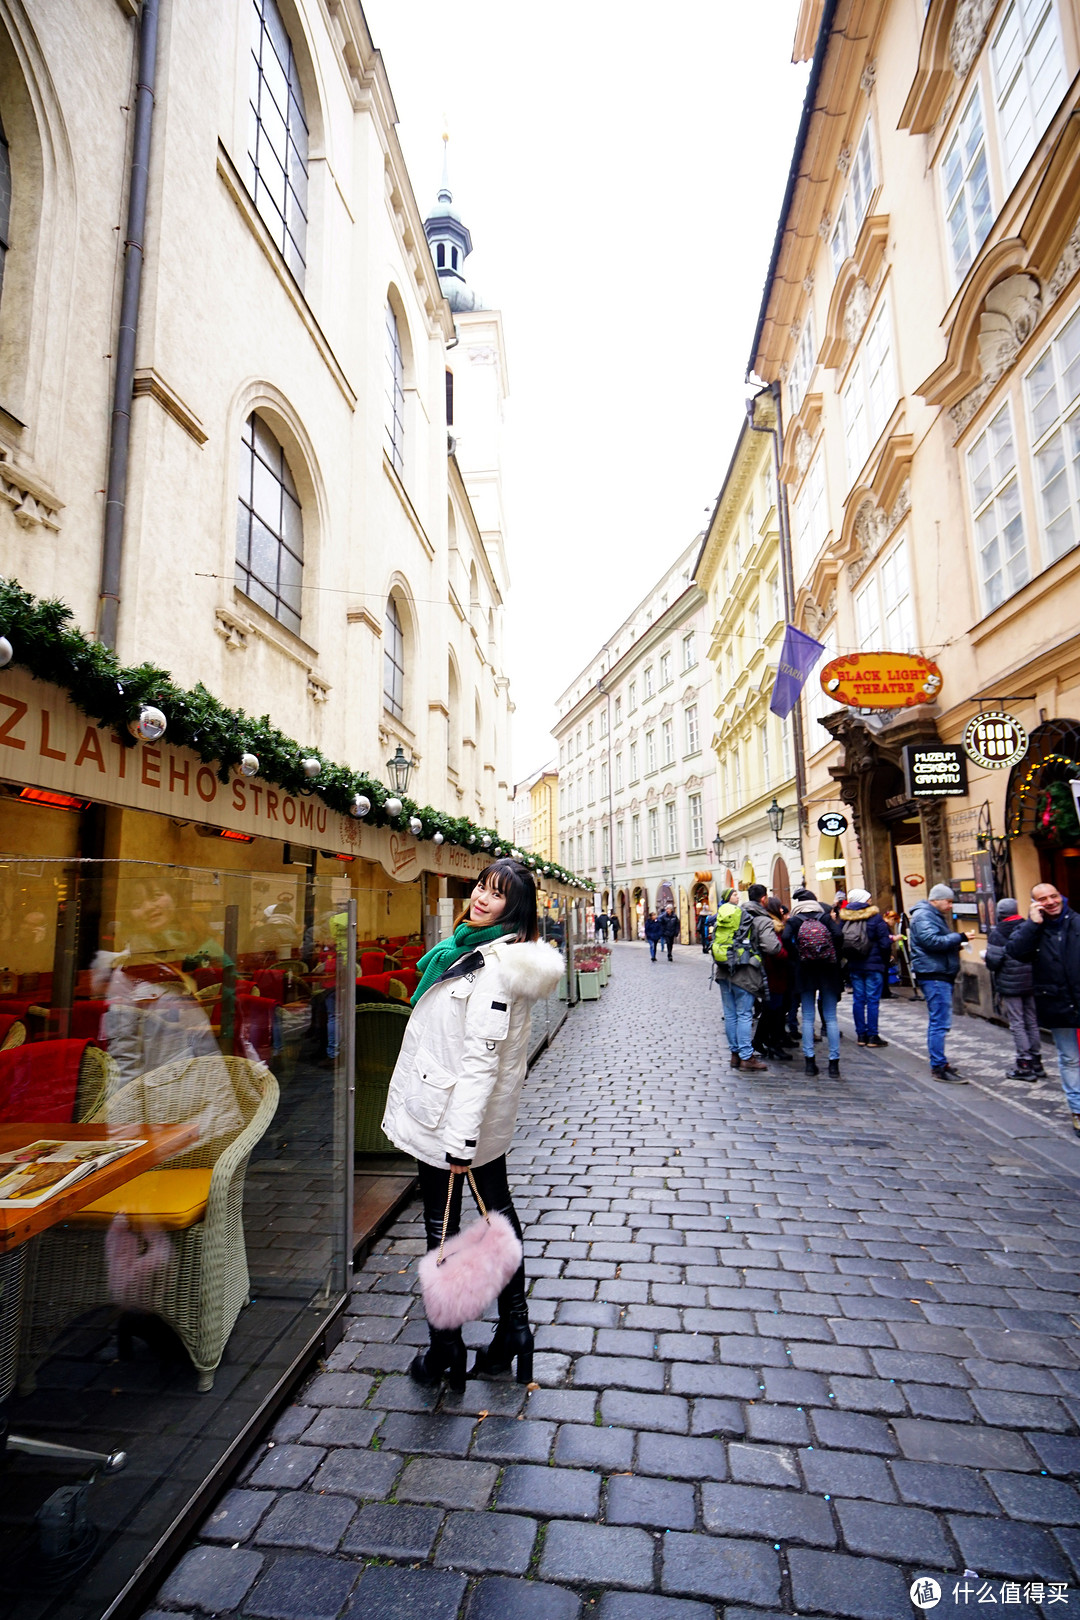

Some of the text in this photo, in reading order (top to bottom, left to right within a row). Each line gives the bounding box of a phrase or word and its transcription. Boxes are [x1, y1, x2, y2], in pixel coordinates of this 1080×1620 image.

[837, 670, 927, 681] BLACK LIGHT
[853, 682, 915, 694] THEATRE
[977, 723, 1013, 740] GOOD
[979, 739, 1014, 756] FOOD
[914, 752, 956, 762] MUZEUM
[232, 778, 328, 834] STROMU
[449, 847, 471, 868] HOTEL
